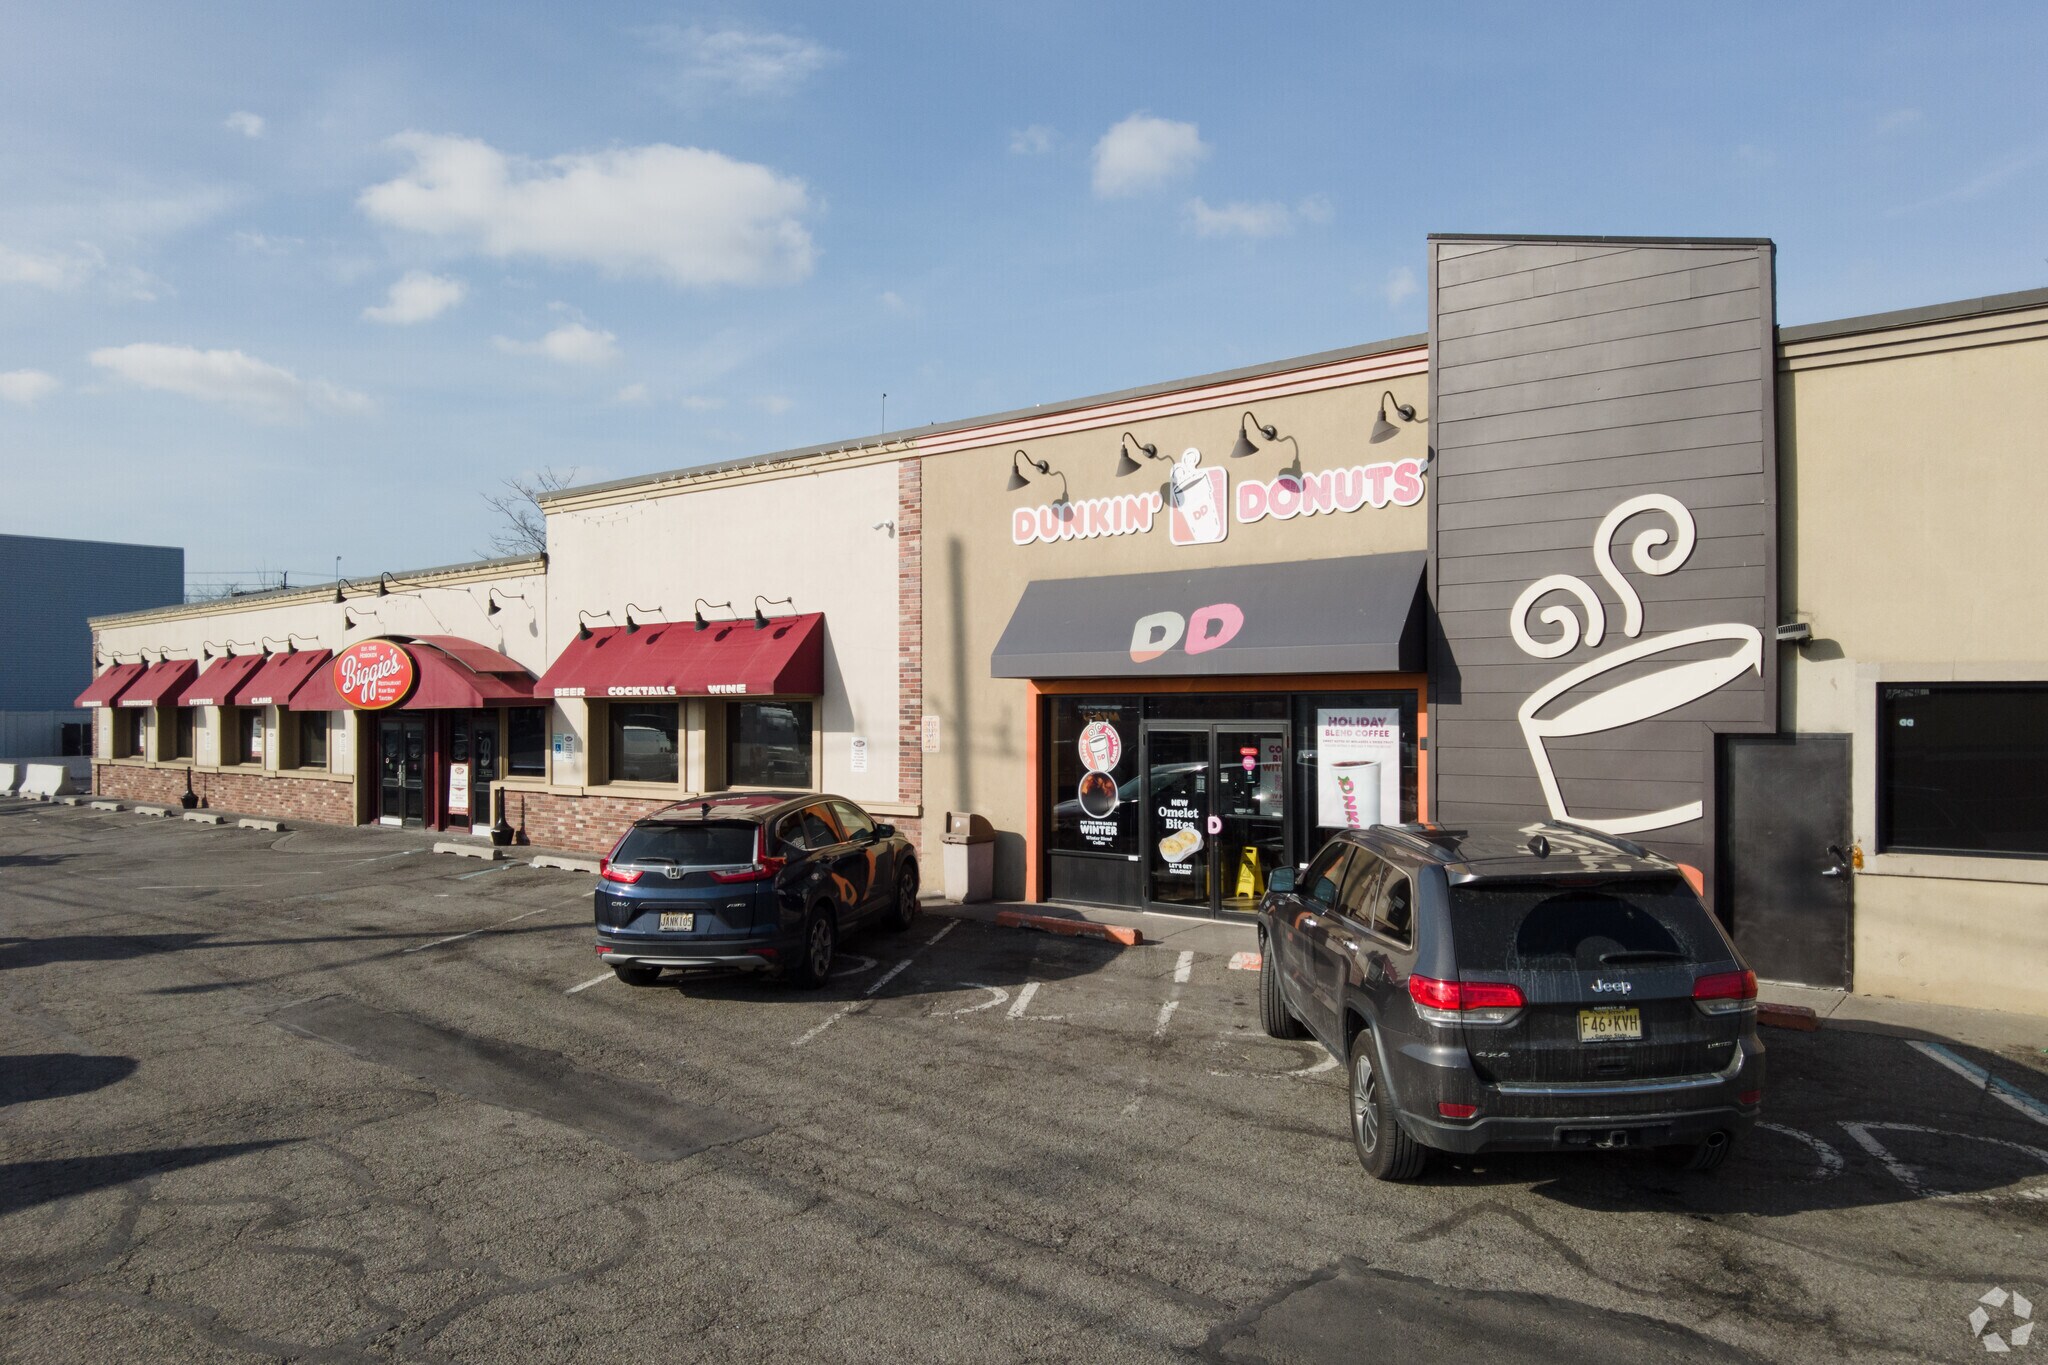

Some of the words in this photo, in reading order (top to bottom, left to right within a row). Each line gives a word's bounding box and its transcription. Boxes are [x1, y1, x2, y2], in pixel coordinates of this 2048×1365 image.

[1014, 493, 1162, 541] DUNKIN'
[1193, 505, 1208, 520] DD
[1130, 603, 1244, 663] DD
[341, 648, 401, 704] Biggie's
[554, 687, 586, 697] BEER
[607, 685, 677, 696] COCKTAILS
[707, 684, 747, 694] WINE
[1328, 716, 1387, 727] HOLIDAY
[1325, 729, 1353, 737] BLEND
[1355, 729, 1390, 737] COFFEE
[1158, 806, 1199, 818] Omelet
[1080, 825, 1117, 835] WINTER
[1165, 818, 1195, 829] Bites
[1592, 978, 1632, 994] Jeep
